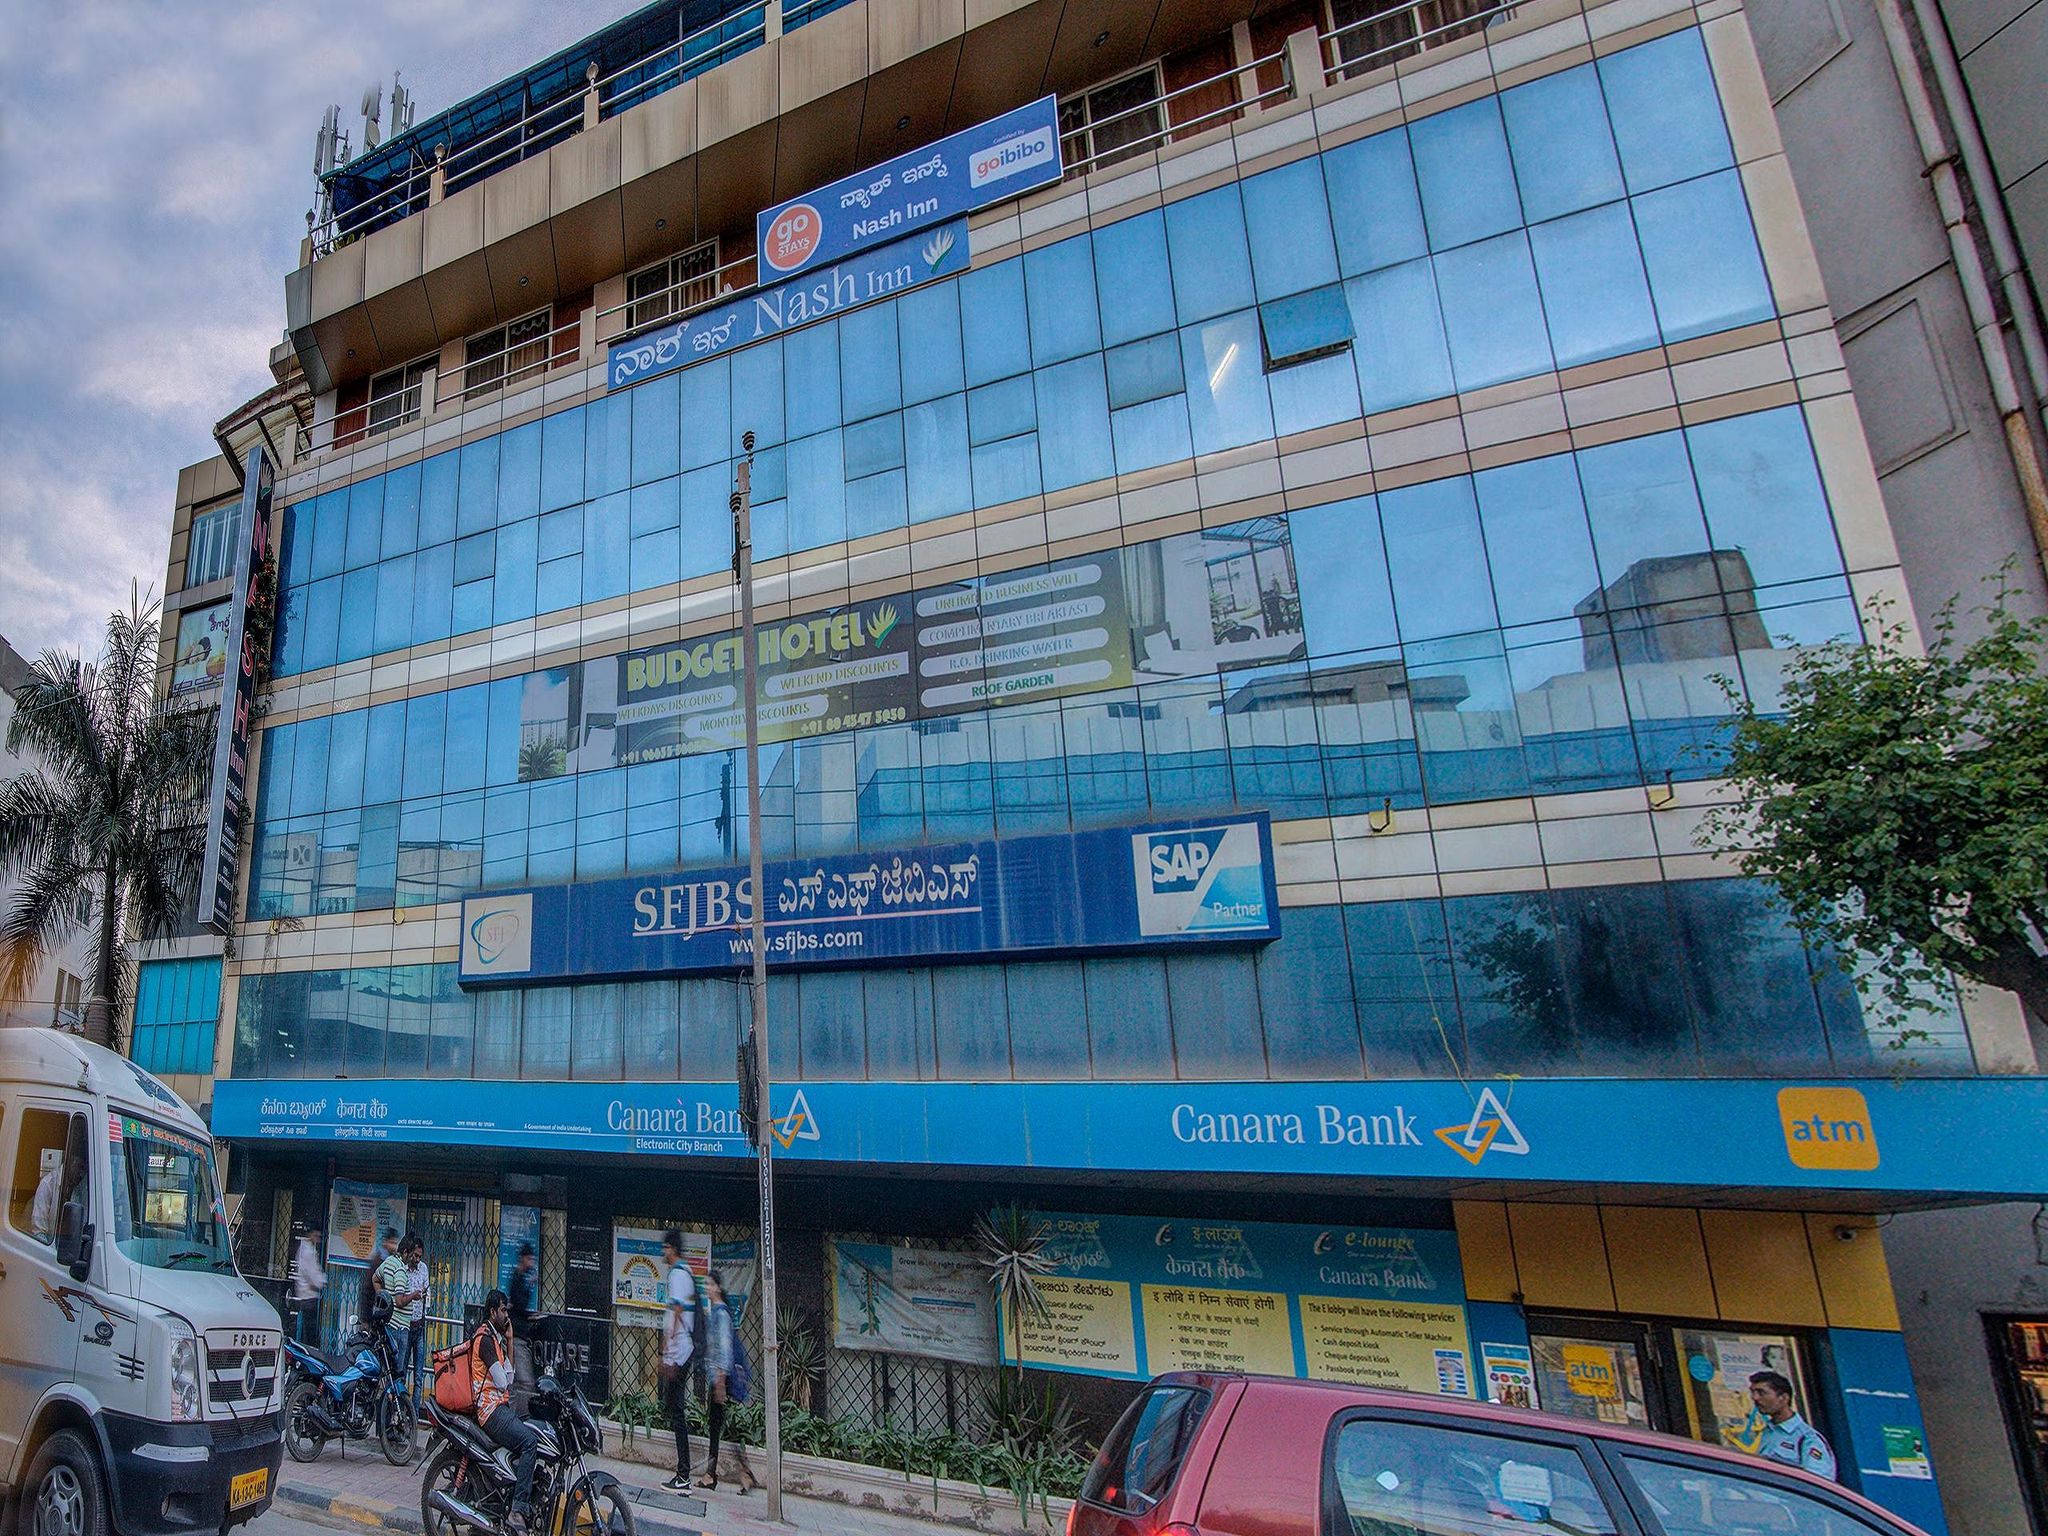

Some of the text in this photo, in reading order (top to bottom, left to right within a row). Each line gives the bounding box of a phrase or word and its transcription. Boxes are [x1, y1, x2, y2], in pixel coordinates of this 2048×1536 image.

[976, 140, 1045, 178] goibibo
[853, 195, 939, 240] Nash Inn
[776, 214, 809, 245] go
[777, 237, 810, 256] STAYS
[752, 264, 914, 338] Nash Inn
[627, 612, 866, 692] BUDGET HOTEL
[974, 645, 1030, 667] DRINKING
[1032, 639, 1073, 655] WATER
[780, 659, 900, 691] WEEKEND DISCOUNTS
[972, 674, 1054, 698] ROOF GARDEN
[617, 691, 723, 721] WEEKDAYS DISCOUNTS
[757, 703, 810, 723] ISCOUNTS
[801, 719, 822, 735] +91
[1151, 842, 1210, 884] SAP
[634, 877, 753, 941] SFJBS
[1213, 902, 1263, 917] Partner
[261, 1098, 327, 1120] ಕೆನರಾ ಬ್ಯಾಂಕ್
[336, 1097, 388, 1119] केनरा बैंक
[607, 1100, 742, 1134] Canara Ban
[567, 1125, 592, 1133] Undertaking
[1171, 1103, 1423, 1146] Canara Bank
[1791, 1114, 1865, 1142] atm
[636, 1138, 723, 1153] Electronic City Branch
[1344, 1232, 1415, 1253] e-lounge
[1165, 1254, 1246, 1279] केनरा बैंक
[1319, 1266, 1428, 1289] Canara Bank
[1187, 1290, 1196, 1304] में
[1198, 1291, 1221, 1307] निम्न
[1308, 1302, 1456, 1323] The E lobby will have the following services
[233, 1334, 267, 1346] FORCE
[1321, 1325, 1453, 1342] Service through Automatic Teller Machine
[1322, 1338, 1379, 1349] Cash deposit kiosk
[1324, 1350, 1390, 1363] Cheque deposit kiosk
[1325, 1365, 1400, 1378] Passbook printing kiosk
[1570, 1360, 1609, 1379] atm
